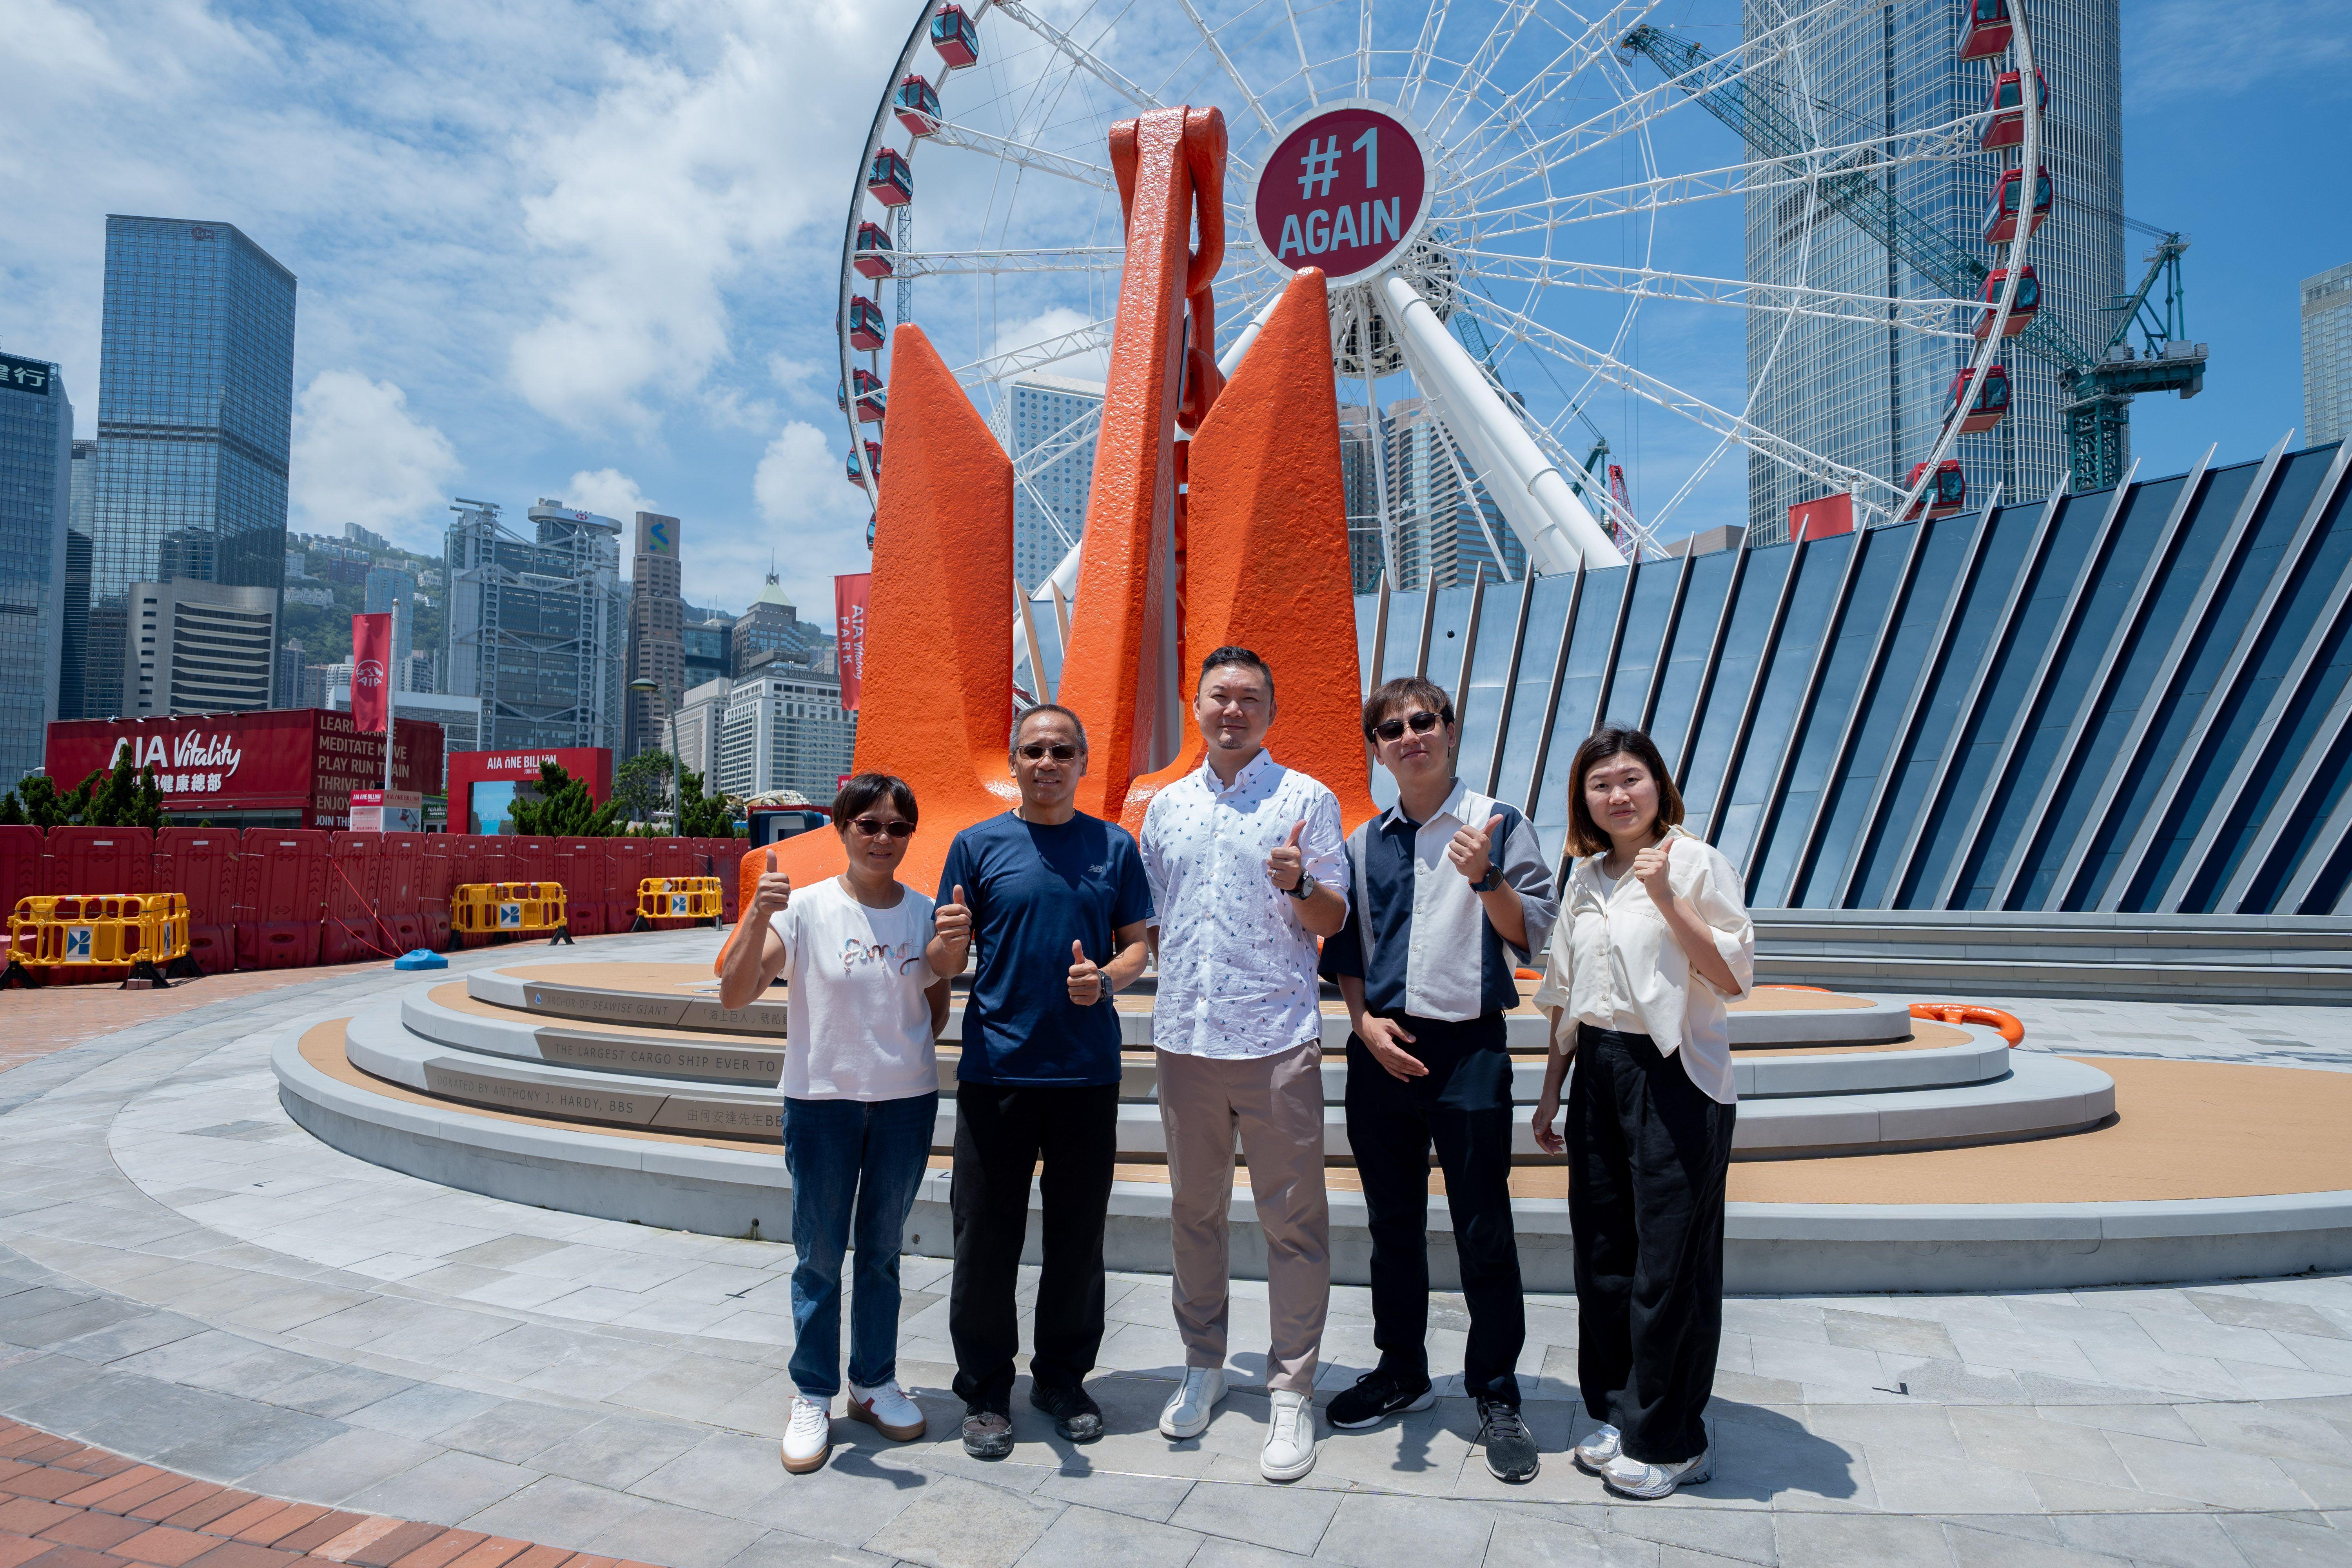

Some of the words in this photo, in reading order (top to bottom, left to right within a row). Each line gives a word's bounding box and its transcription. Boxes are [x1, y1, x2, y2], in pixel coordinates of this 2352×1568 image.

[1298, 127, 1377, 200] #1
[1277, 197, 1400, 260] AGAIN
[852, 604, 864, 639] AIA
[840, 616, 852, 664] PARK
[853, 641, 864, 680] Vitality
[357, 677, 382, 687] AIA
[789, 671, 824, 681] MANDARIN
[109, 735, 168, 769] AIA
[174, 729, 241, 777] Vitality
[319, 735, 374, 755] MEDITATE
[377, 744, 407, 760] MVE
[318, 755, 348, 771] PLAY
[351, 759, 374, 774] RUN
[487, 757, 502, 769] AIA
[132, 773, 221, 793] B健康總部
[362, 779, 398, 791] LAH
[315, 815, 334, 826] JOIN
[336, 817, 350, 827] THE
[547, 996, 576, 1007] ANCHOR
[579, 999, 589, 1009] OF
[593, 1000, 633, 1013] SEAWISE
[637, 1004, 668, 1016] GIANT
[555, 1044, 573, 1055] THE
[578, 1047, 625, 1060] LARGEST
[631, 1051, 671, 1064] CARGO
[679, 1055, 708, 1067] SHIP
[716, 1058, 750, 1070] EVER
[758, 1060, 775, 1072] TO
[437, 1075, 474, 1091] DONATED
[479, 1083, 489, 1094] BY
[494, 1085, 540, 1102] ANTHONY
[545, 1093, 554, 1104] J.
[561, 1094, 602, 1112] HARDY,
[610, 1101, 633, 1113] BBS
